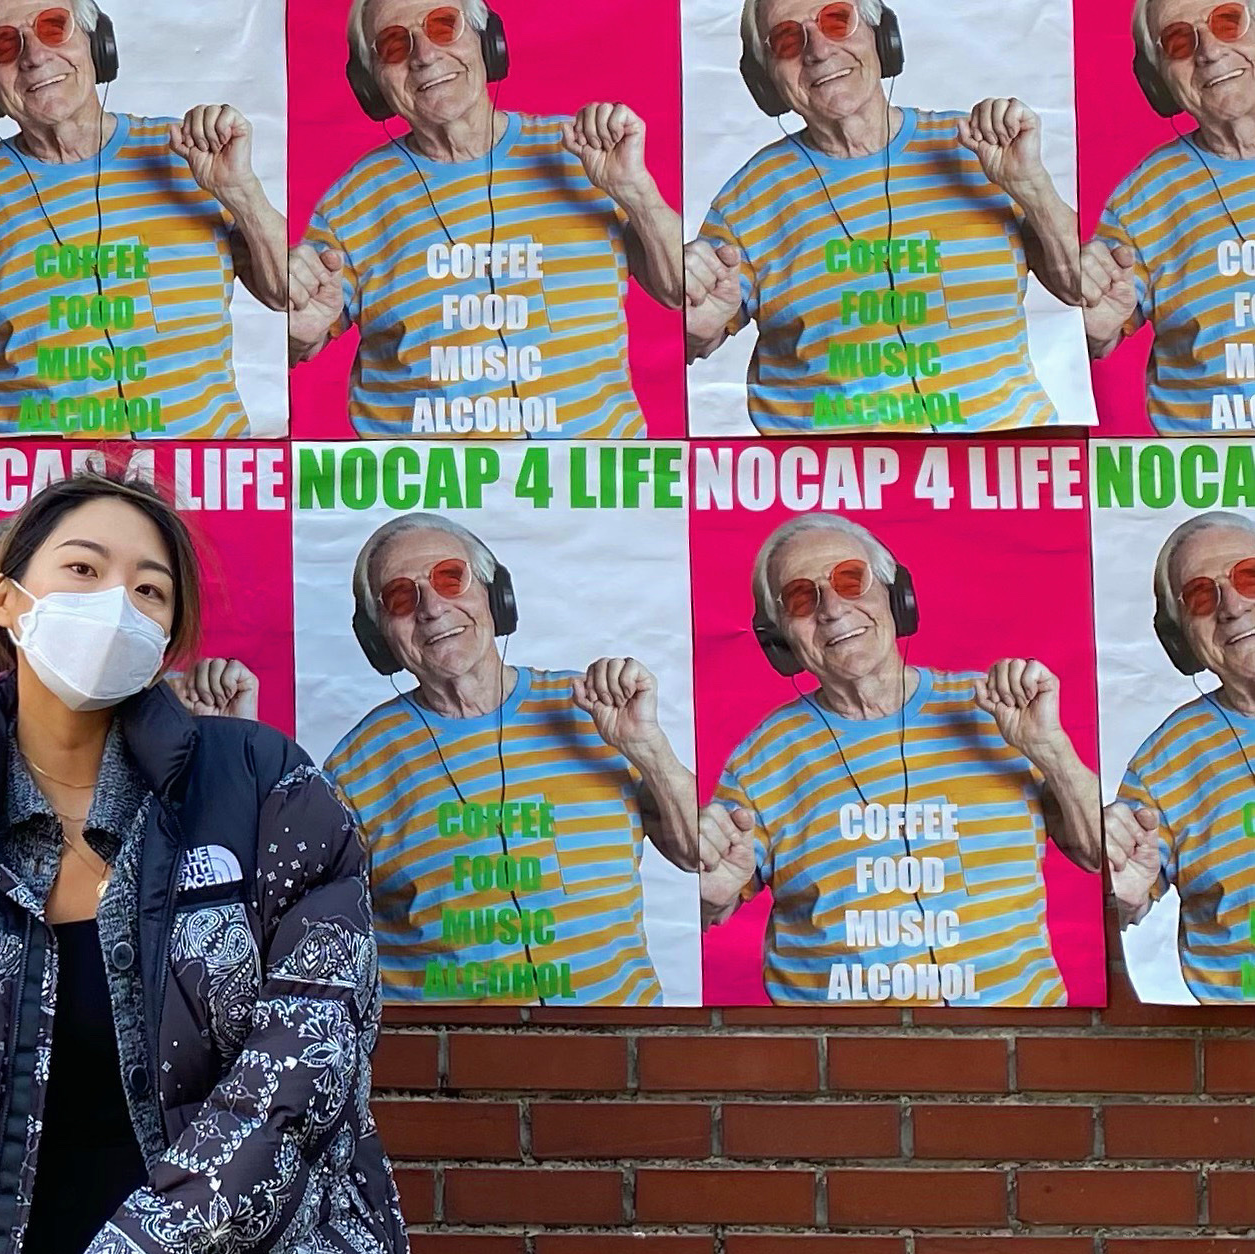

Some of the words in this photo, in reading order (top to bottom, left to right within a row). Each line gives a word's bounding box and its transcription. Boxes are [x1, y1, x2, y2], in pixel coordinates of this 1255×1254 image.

[34, 243, 150, 280] COFFEE
[426, 242, 544, 280] COFFEE
[825, 239, 941, 275] COFFEE
[49, 295, 135, 331] FOOD
[442, 295, 528, 331] FOOD
[841, 290, 927, 327] FOOD
[36, 346, 148, 383] MUSIC
[429, 346, 543, 382] MUSIC
[828, 342, 942, 379] MUSIC
[16, 397, 167, 434] ALCOHOL
[411, 396, 562, 433] ALCOHOL
[813, 392, 968, 429] ALCOHOL
[174, 448, 286, 511] LIFE
[299, 446, 501, 511] NOCAP
[514, 447, 554, 510] 4
[569, 447, 683, 510] LIFE
[695, 445, 902, 511] NOCAP
[914, 446, 954, 509] 4
[967, 446, 1084, 510] LIFE
[1096, 445, 1255, 509] NOCA
[437, 801, 555, 840] COFFEE
[839, 802, 960, 842] COFFEE
[186, 846, 208, 862] HE
[178, 873, 216, 892] ACE
[454, 854, 542, 892] FOOD
[856, 856, 945, 895] FOOD
[441, 908, 556, 946] MUSIC
[845, 910, 961, 949] MUSIC
[423, 962, 577, 1000] ALCOHOL
[827, 963, 982, 1002] ALCOHOL
